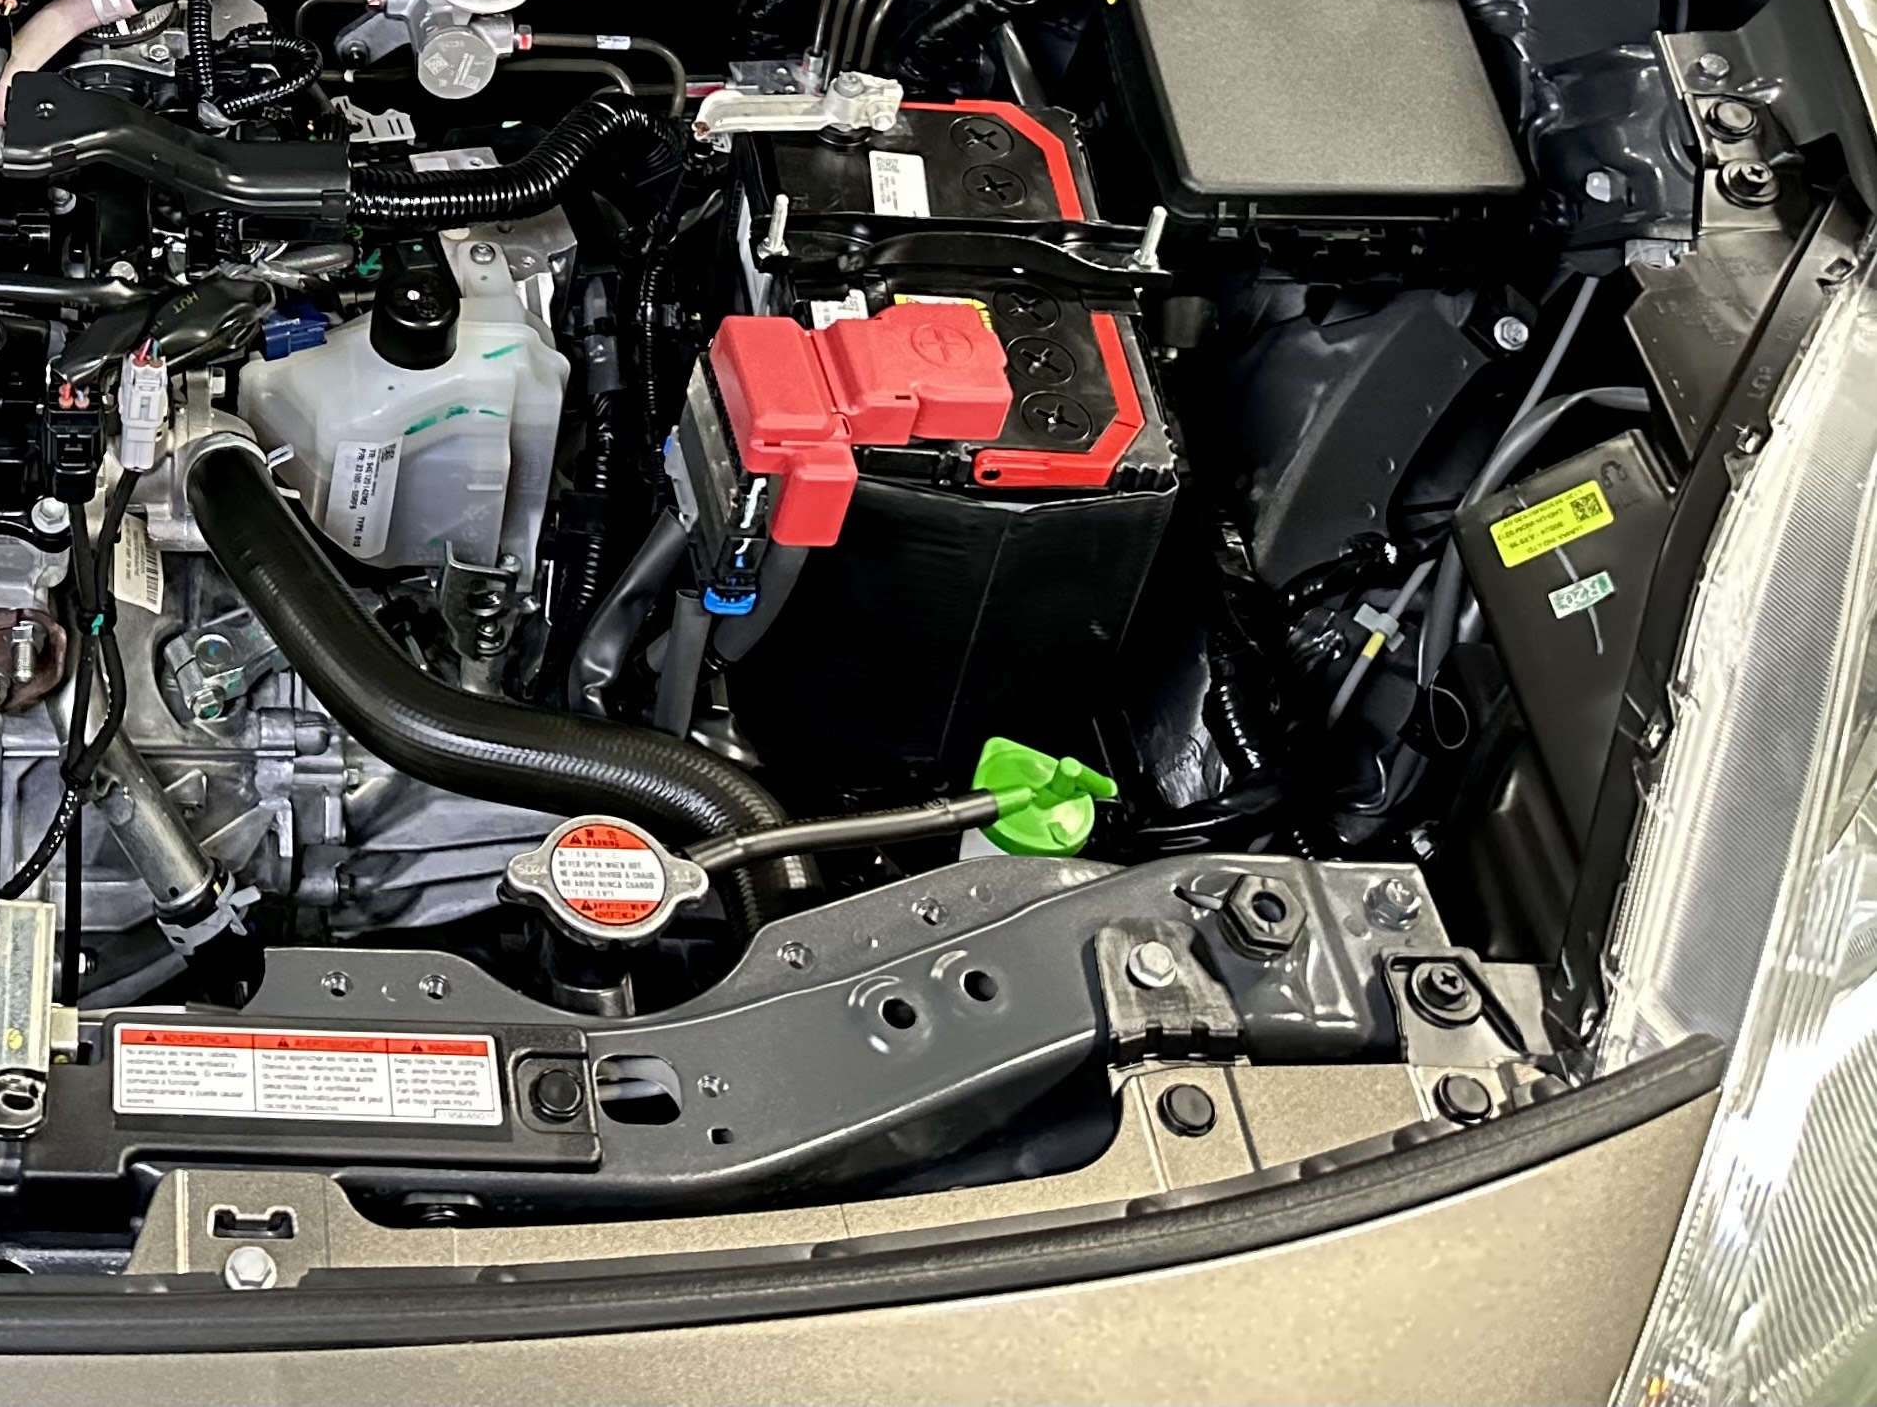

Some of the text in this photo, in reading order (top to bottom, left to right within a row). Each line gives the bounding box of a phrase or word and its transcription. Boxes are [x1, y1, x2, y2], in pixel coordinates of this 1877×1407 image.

[173, 290, 199, 313] HUT
[162, 1033, 230, 1044] ADVERTENCIA
[295, 1037, 373, 1049] AVERTISSEMENT
[427, 1043, 473, 1053] WARNING
